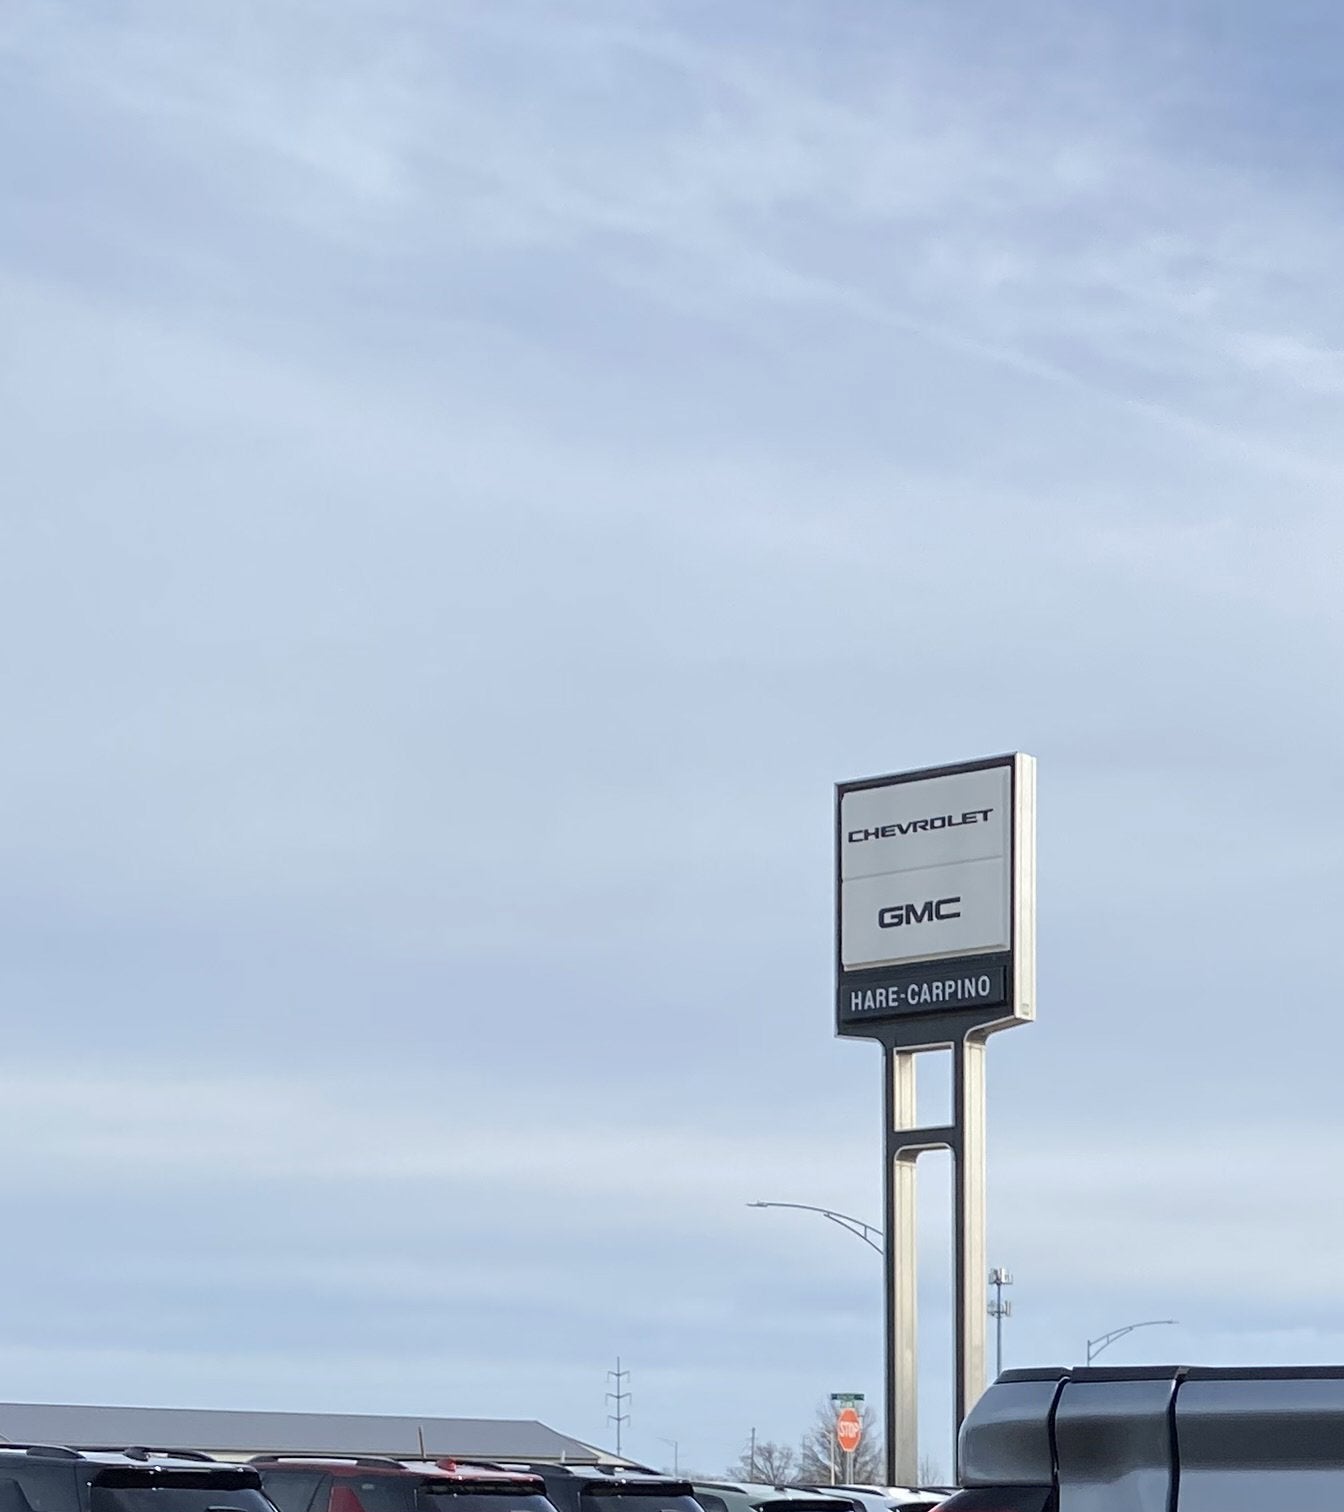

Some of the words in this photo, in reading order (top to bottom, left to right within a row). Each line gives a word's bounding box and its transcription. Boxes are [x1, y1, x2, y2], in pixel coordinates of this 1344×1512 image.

[848, 809, 994, 843] CHEVROLET
[878, 896, 961, 929] GMC
[851, 975, 990, 1011] HARE-CARPINO
[840, 1421, 858, 1438] STOP
